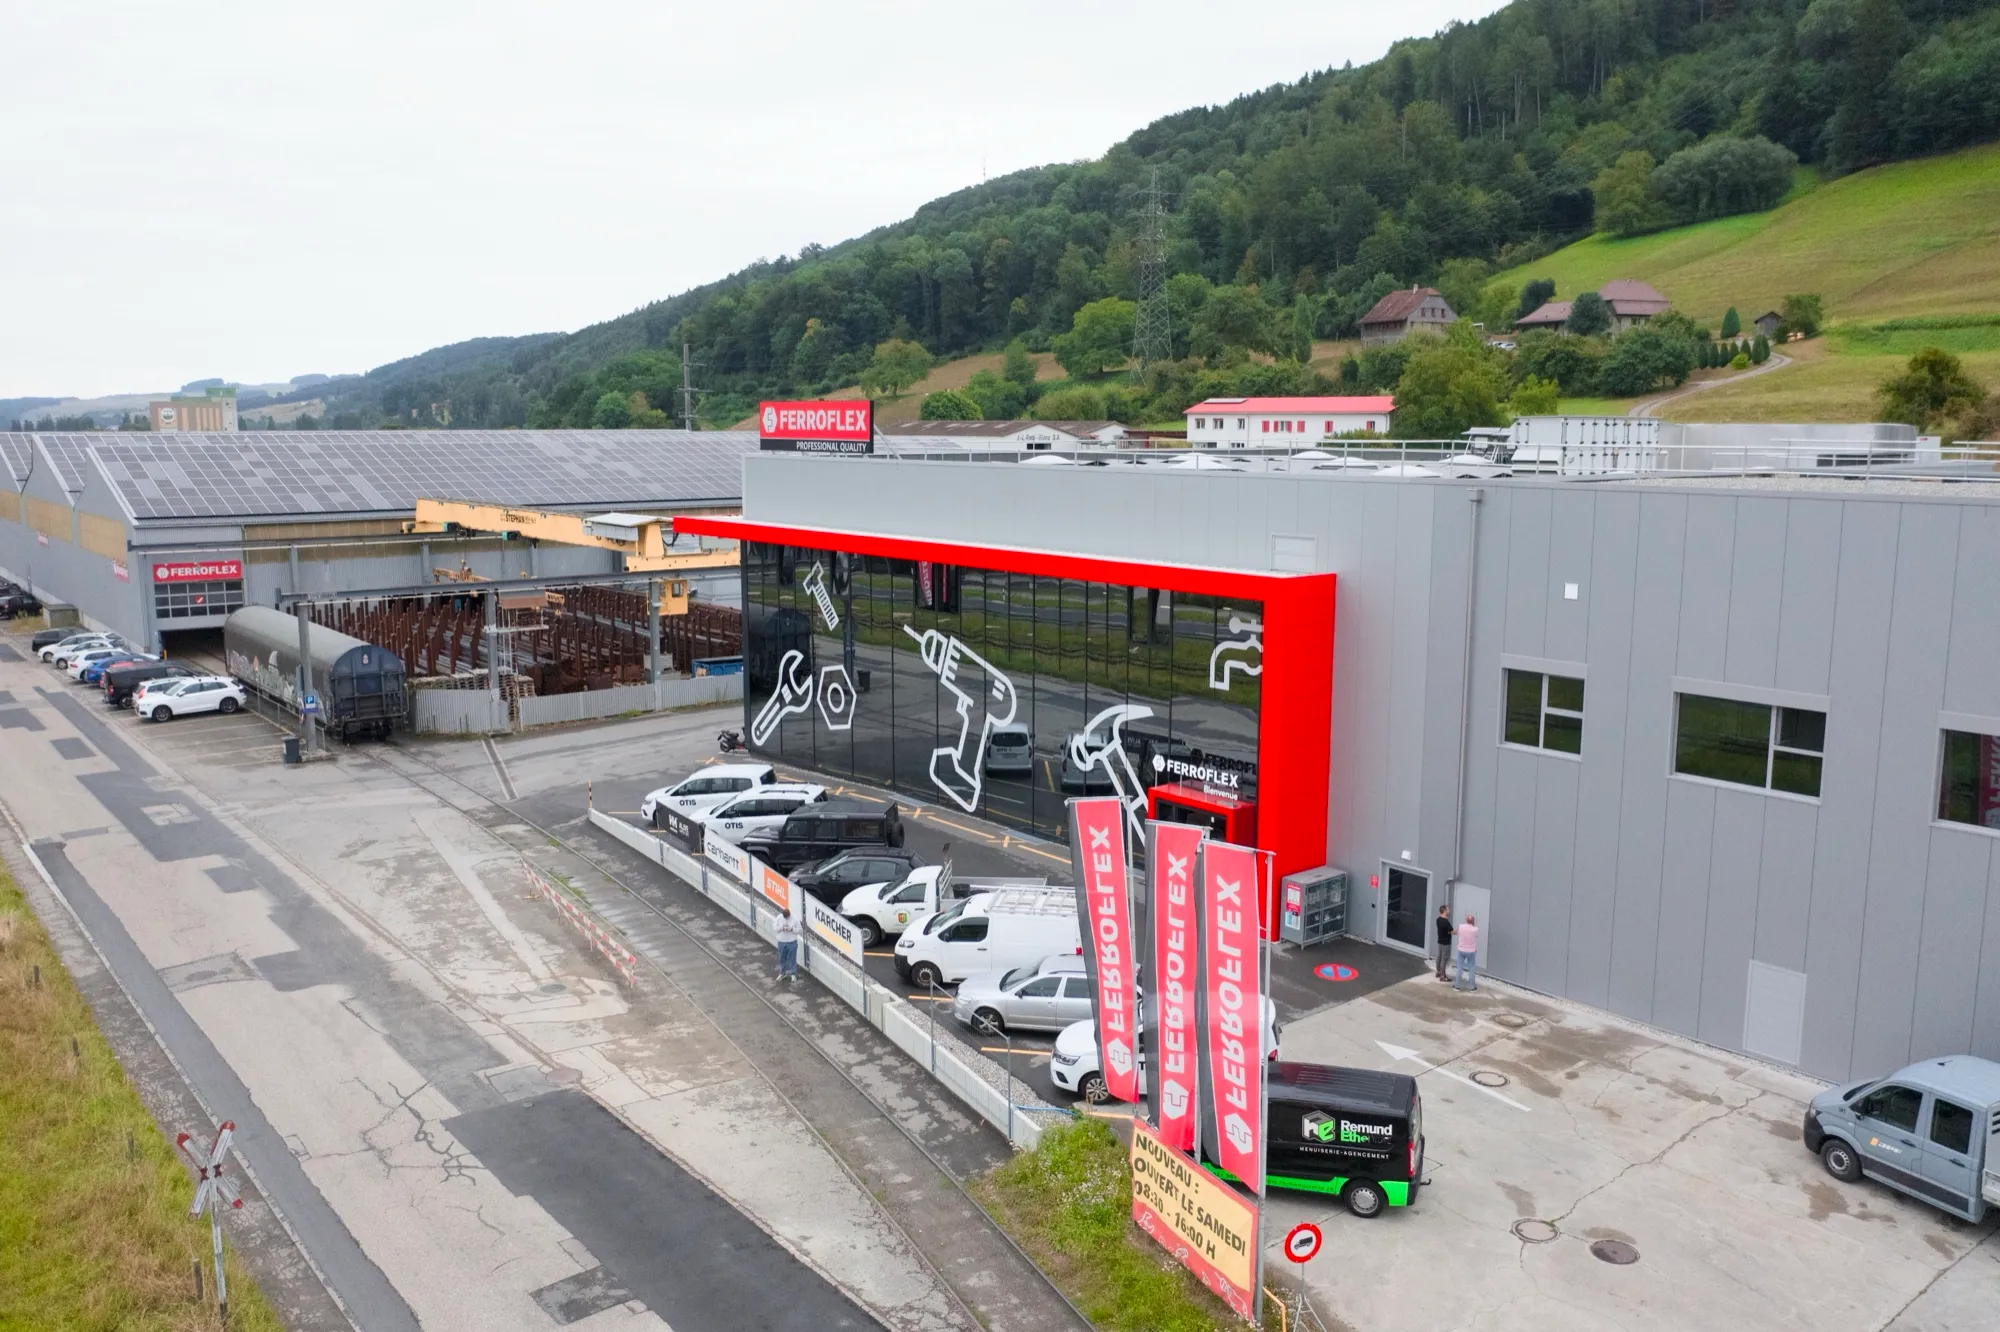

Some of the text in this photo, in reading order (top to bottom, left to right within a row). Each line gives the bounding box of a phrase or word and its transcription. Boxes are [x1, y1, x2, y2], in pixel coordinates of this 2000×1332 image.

[780, 409, 867, 431] FERROFLEX
[796, 441, 867, 452] PROFESSIONAL QUALITY
[170, 564, 237, 576] FERROFLEX
[1167, 759, 1239, 788] FERROFLEX
[1203, 785, 1238, 801] Bienvenue
[707, 841, 740, 870] carhartt
[766, 877, 787, 900] STIHL
[1340, 1119, 1393, 1136] Remund
[1136, 1133, 1191, 1188] NOUVEAU
[1299, 1146, 1390, 1159] MENUISERIE-AGENCEMENT
[1134, 1157, 1246, 1256] OUVERT LE SAMEDI
[1134, 1180, 1164, 1214] 08:30
[1175, 1212, 1203, 1249] 16:00
[1206, 1239, 1216, 1260] H
